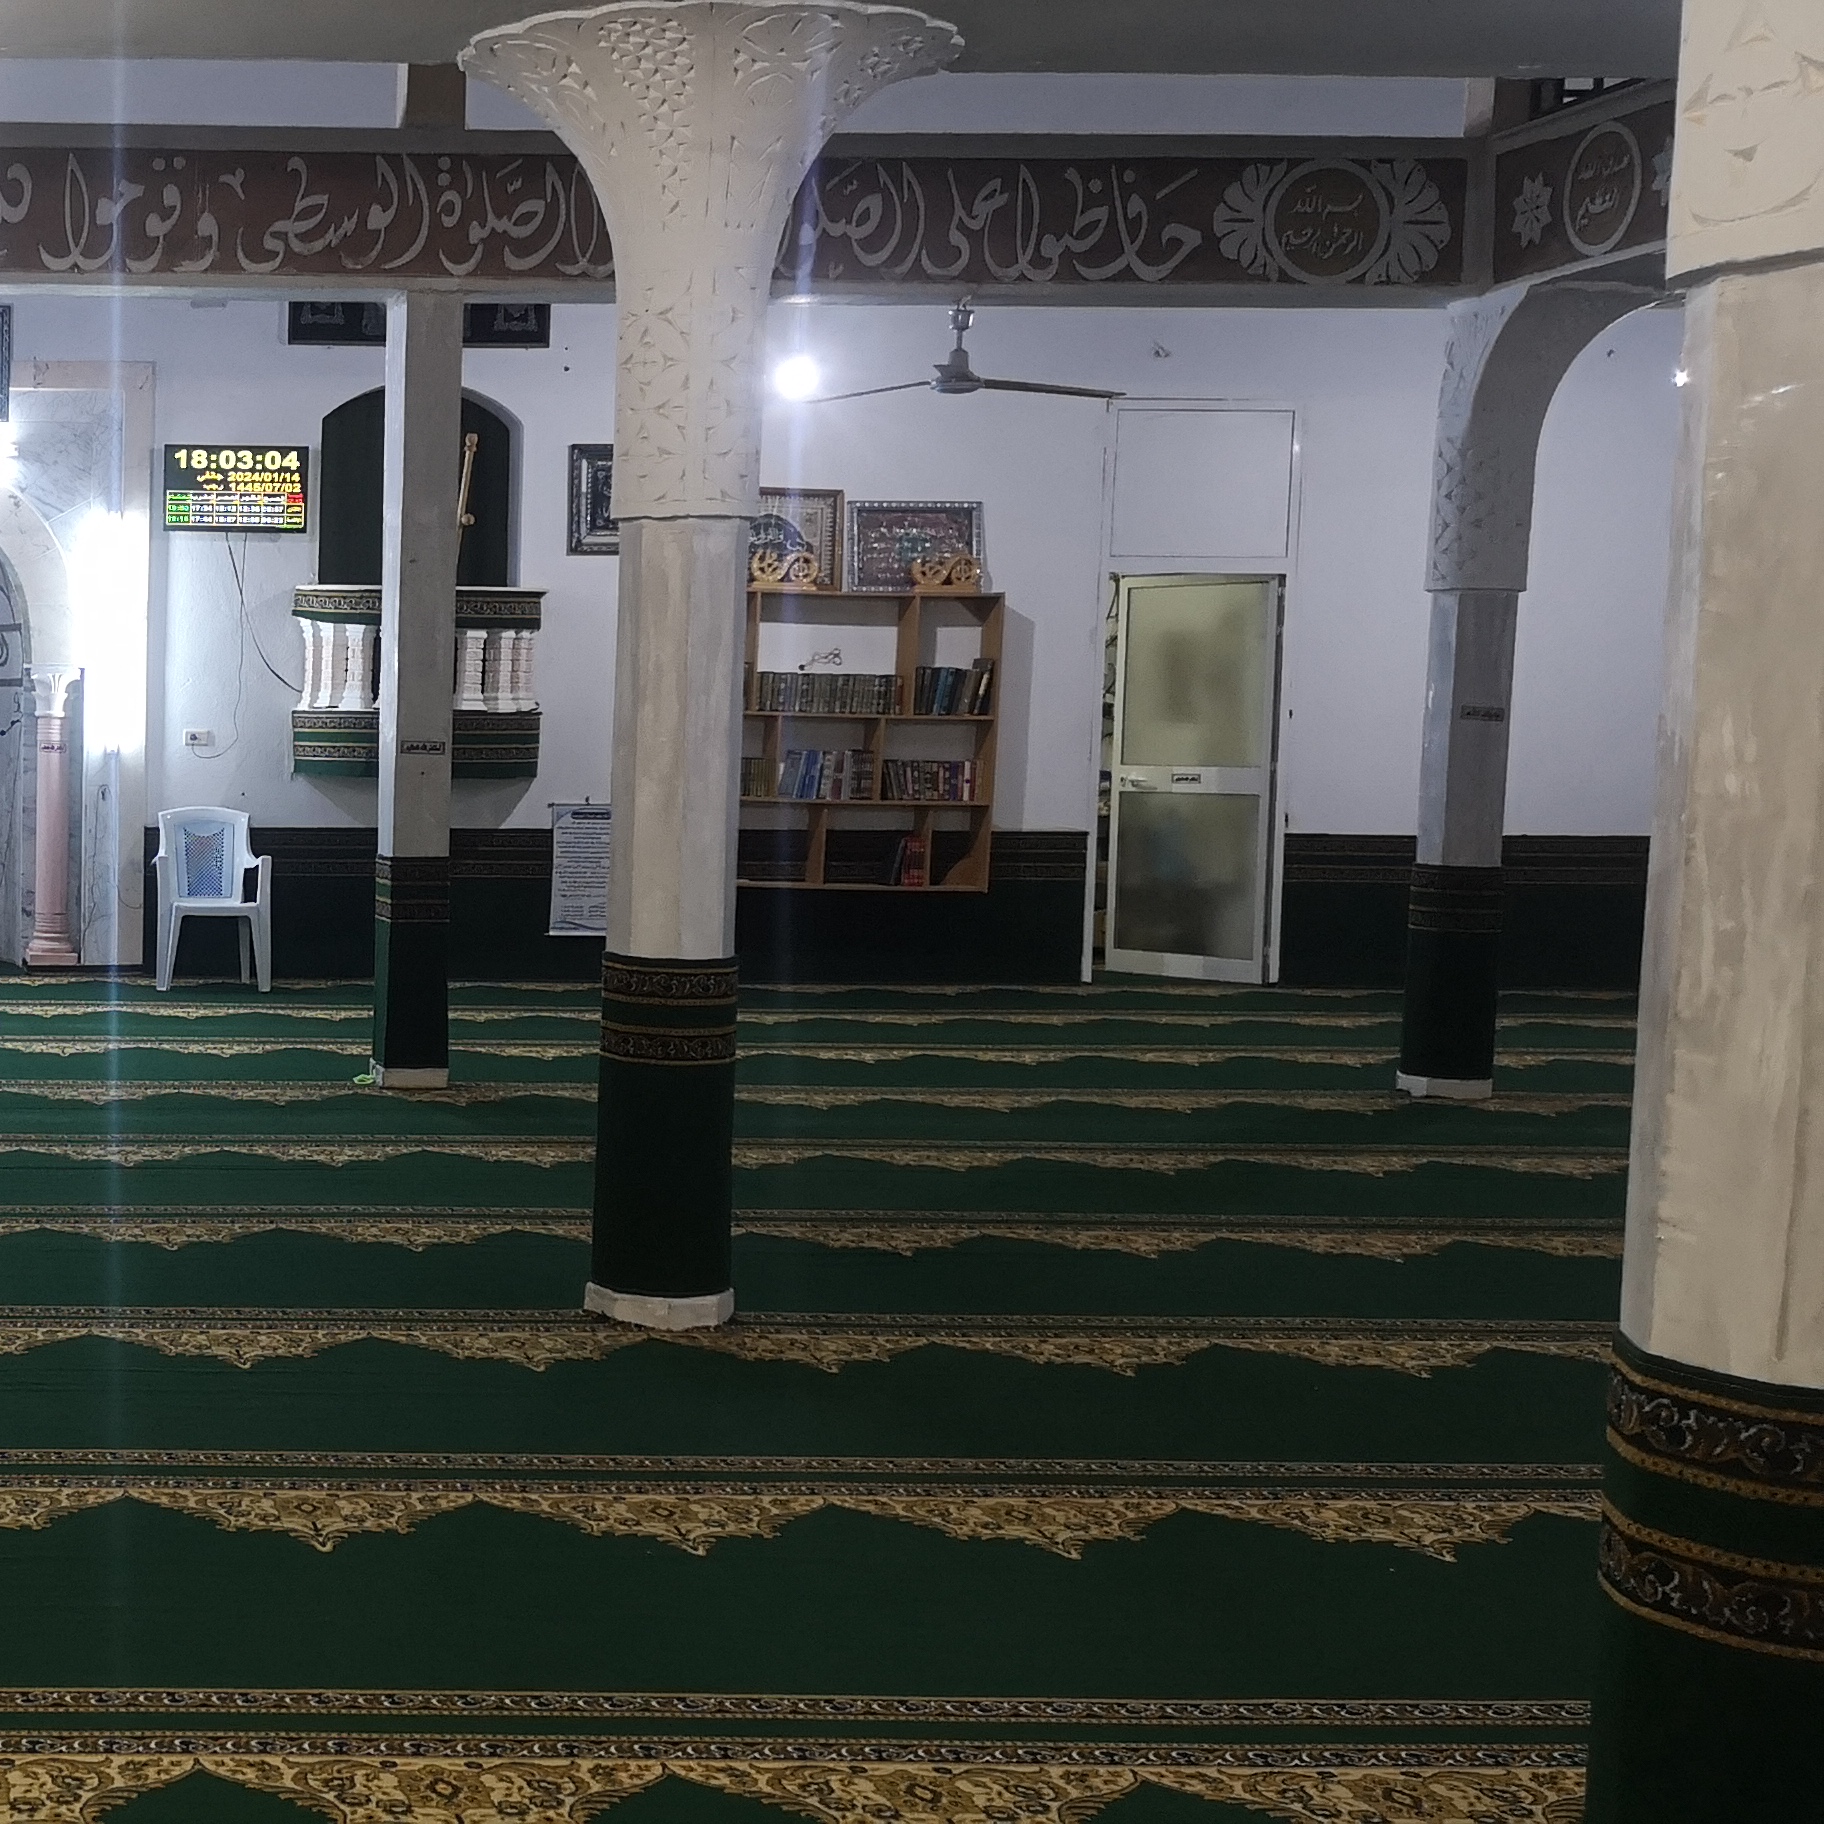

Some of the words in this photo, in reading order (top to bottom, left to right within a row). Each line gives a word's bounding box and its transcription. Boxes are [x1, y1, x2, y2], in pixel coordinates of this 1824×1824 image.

[1289, 184, 1323, 213] الله
[174, 449, 301, 470] 18:03:04
[227, 472, 300, 482] 2024/01/14
[229, 483, 301, 493] 1445/07/02
